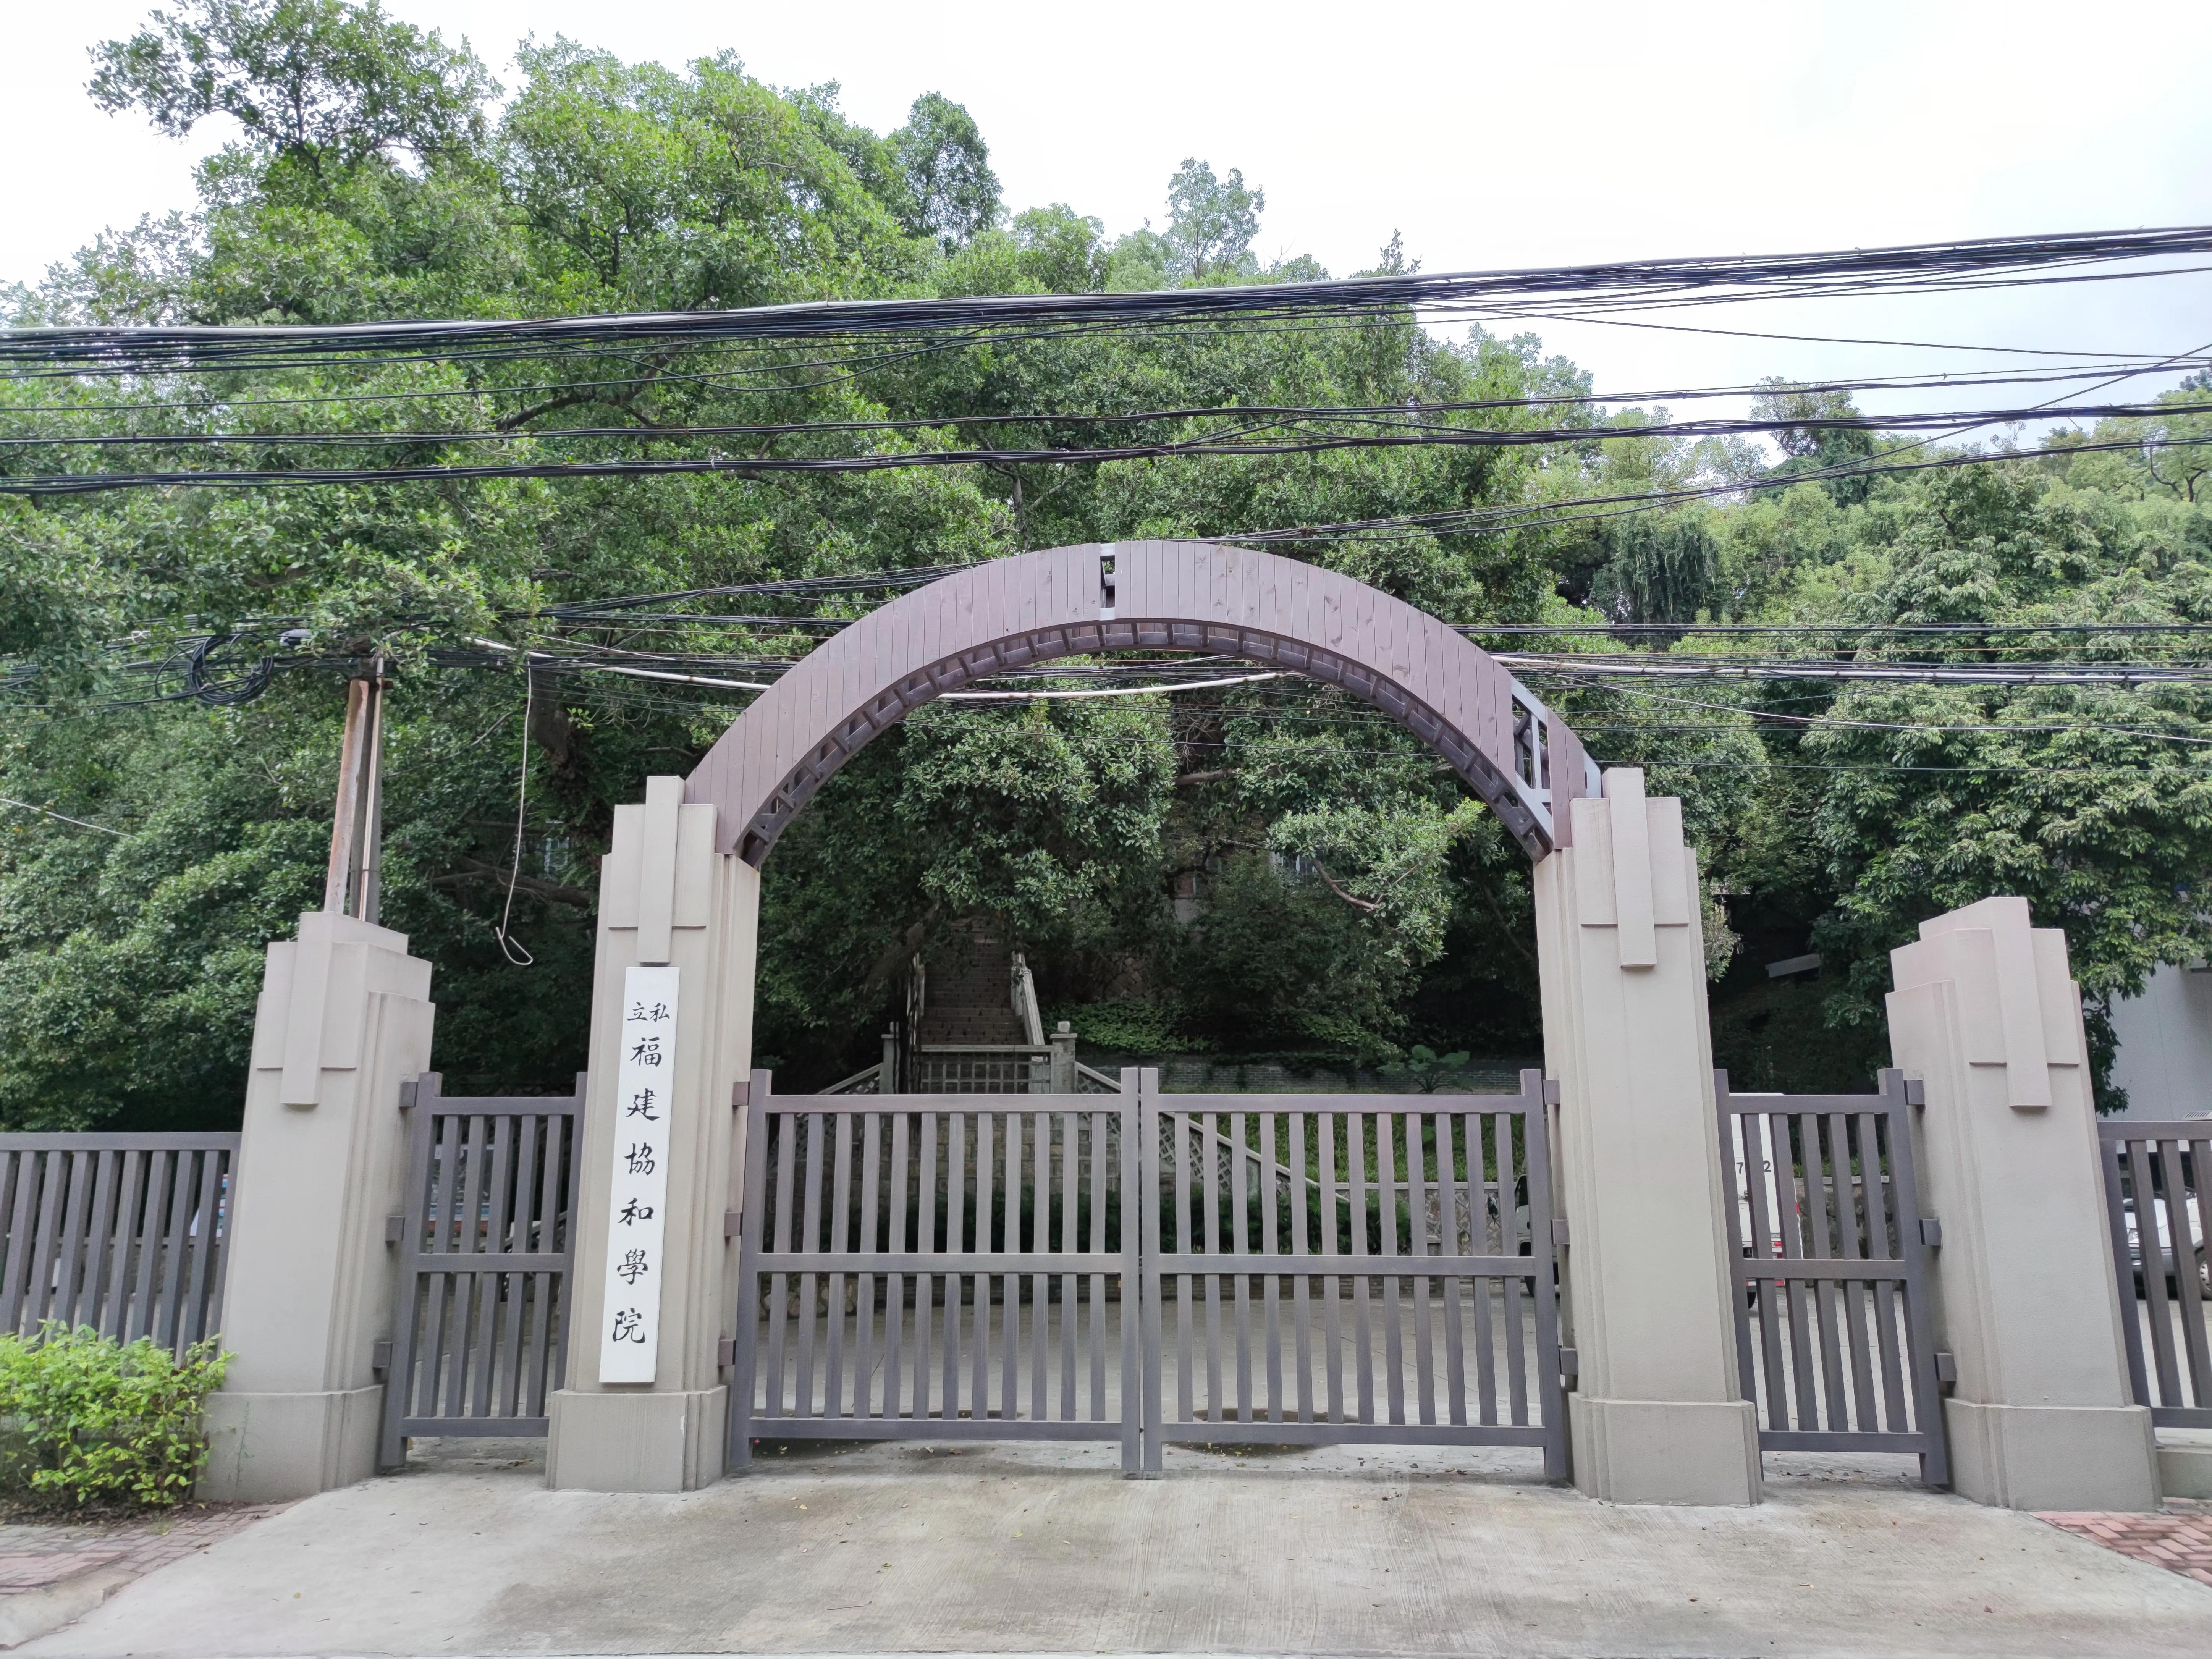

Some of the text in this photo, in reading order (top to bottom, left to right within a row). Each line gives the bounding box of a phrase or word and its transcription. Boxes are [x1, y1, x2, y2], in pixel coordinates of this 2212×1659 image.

[612, 1036, 662, 1344] 福建協和學院
